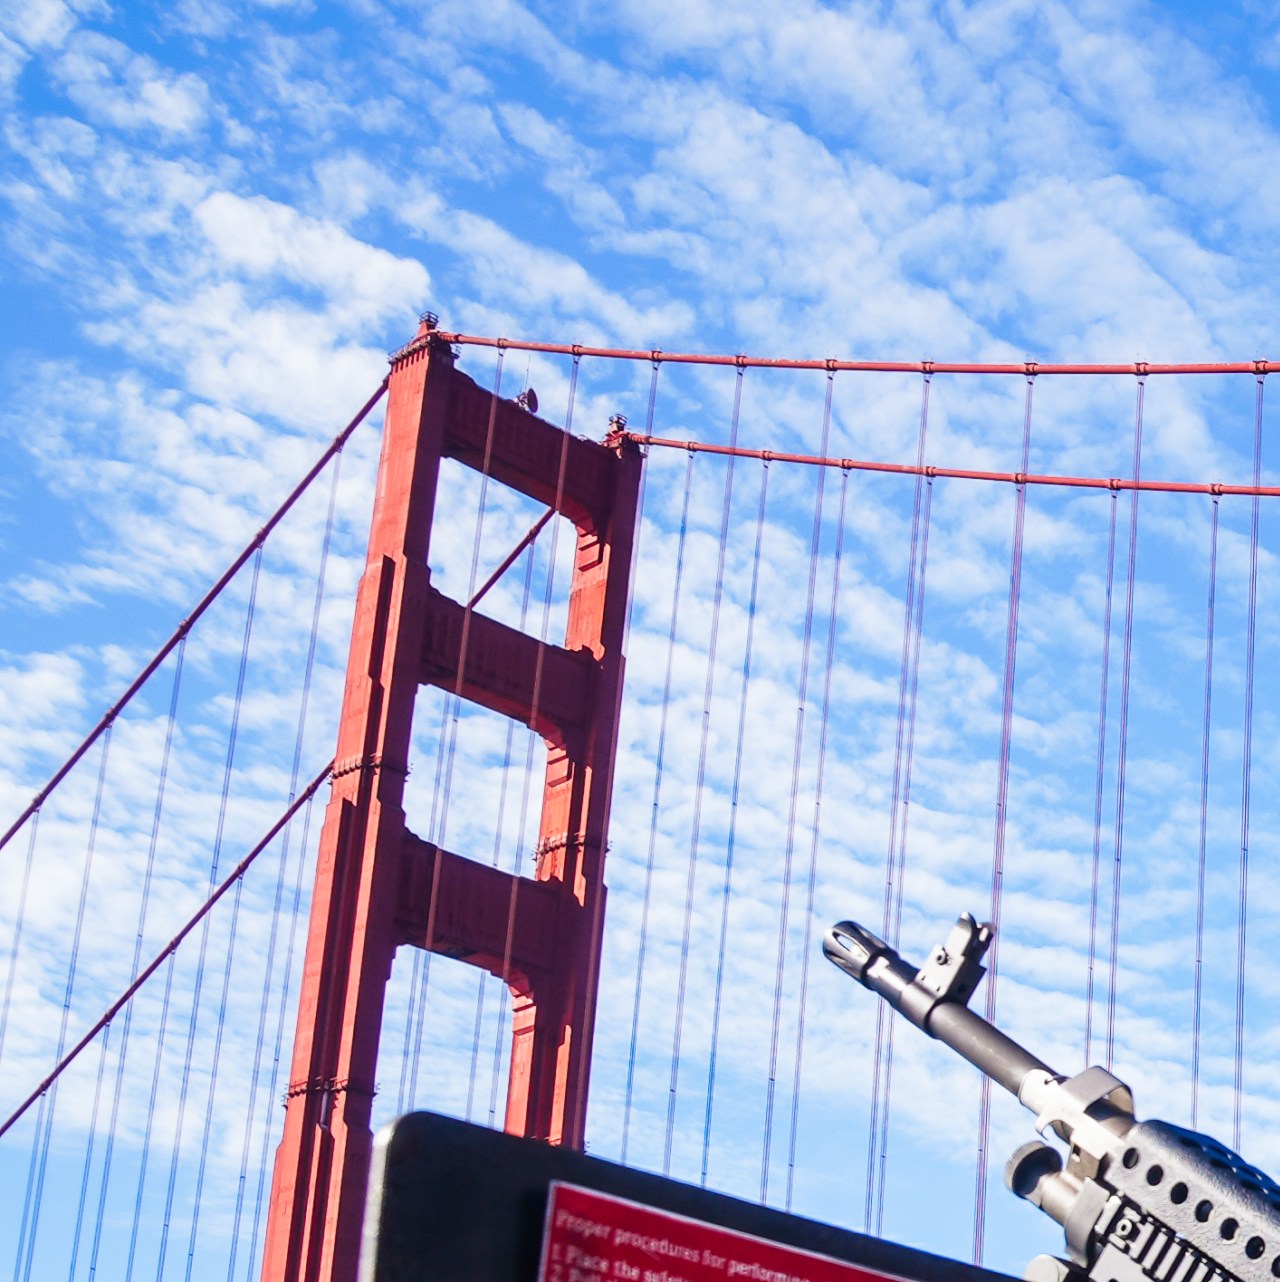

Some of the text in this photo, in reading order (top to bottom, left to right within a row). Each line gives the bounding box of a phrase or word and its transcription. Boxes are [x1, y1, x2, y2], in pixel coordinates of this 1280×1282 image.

[556, 1211, 611, 1237] Proper
[614, 1229, 700, 1262] procedures
[702, 1250, 726, 1268] for
